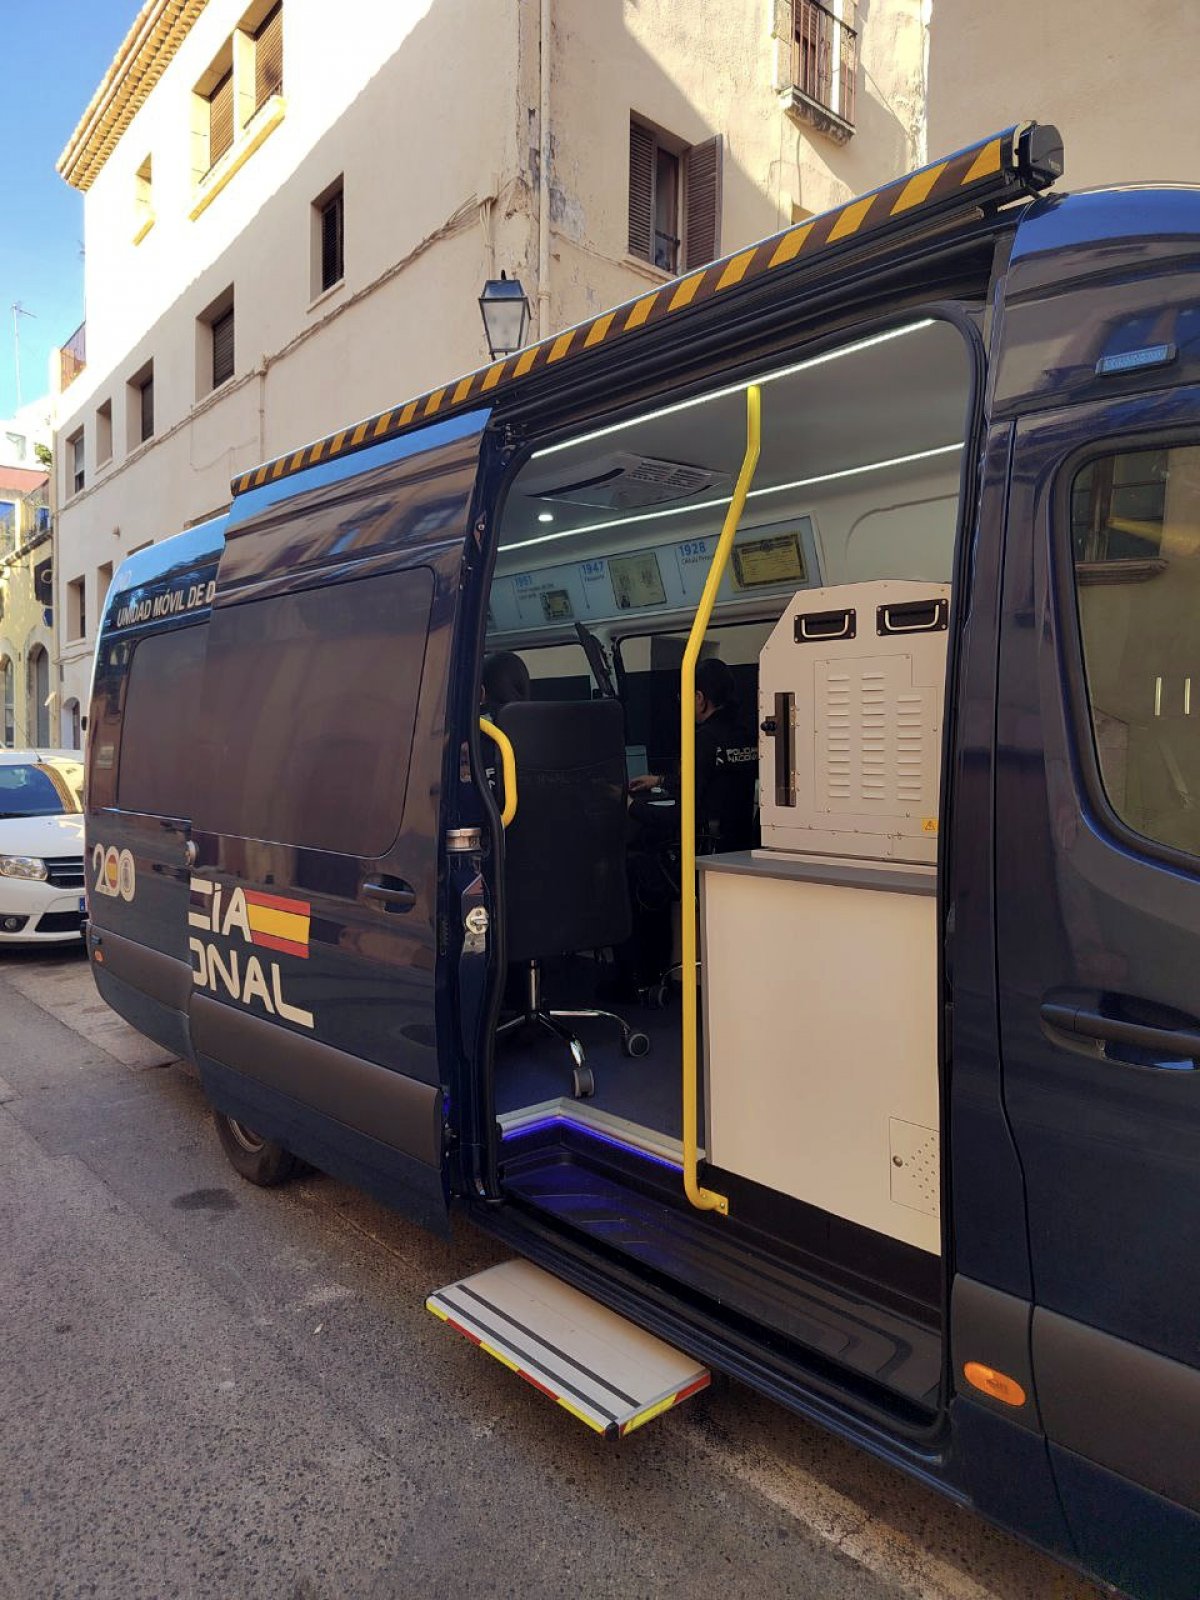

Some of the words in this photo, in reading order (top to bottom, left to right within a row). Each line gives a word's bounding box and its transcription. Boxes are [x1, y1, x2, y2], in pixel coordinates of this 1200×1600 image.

[679, 540, 706, 556] 1928
[116, 600, 151, 627] UNIDAD
[152, 588, 185, 617] MÓVIL
[187, 583, 206, 607] DE
[92, 843, 136, 902] 200
